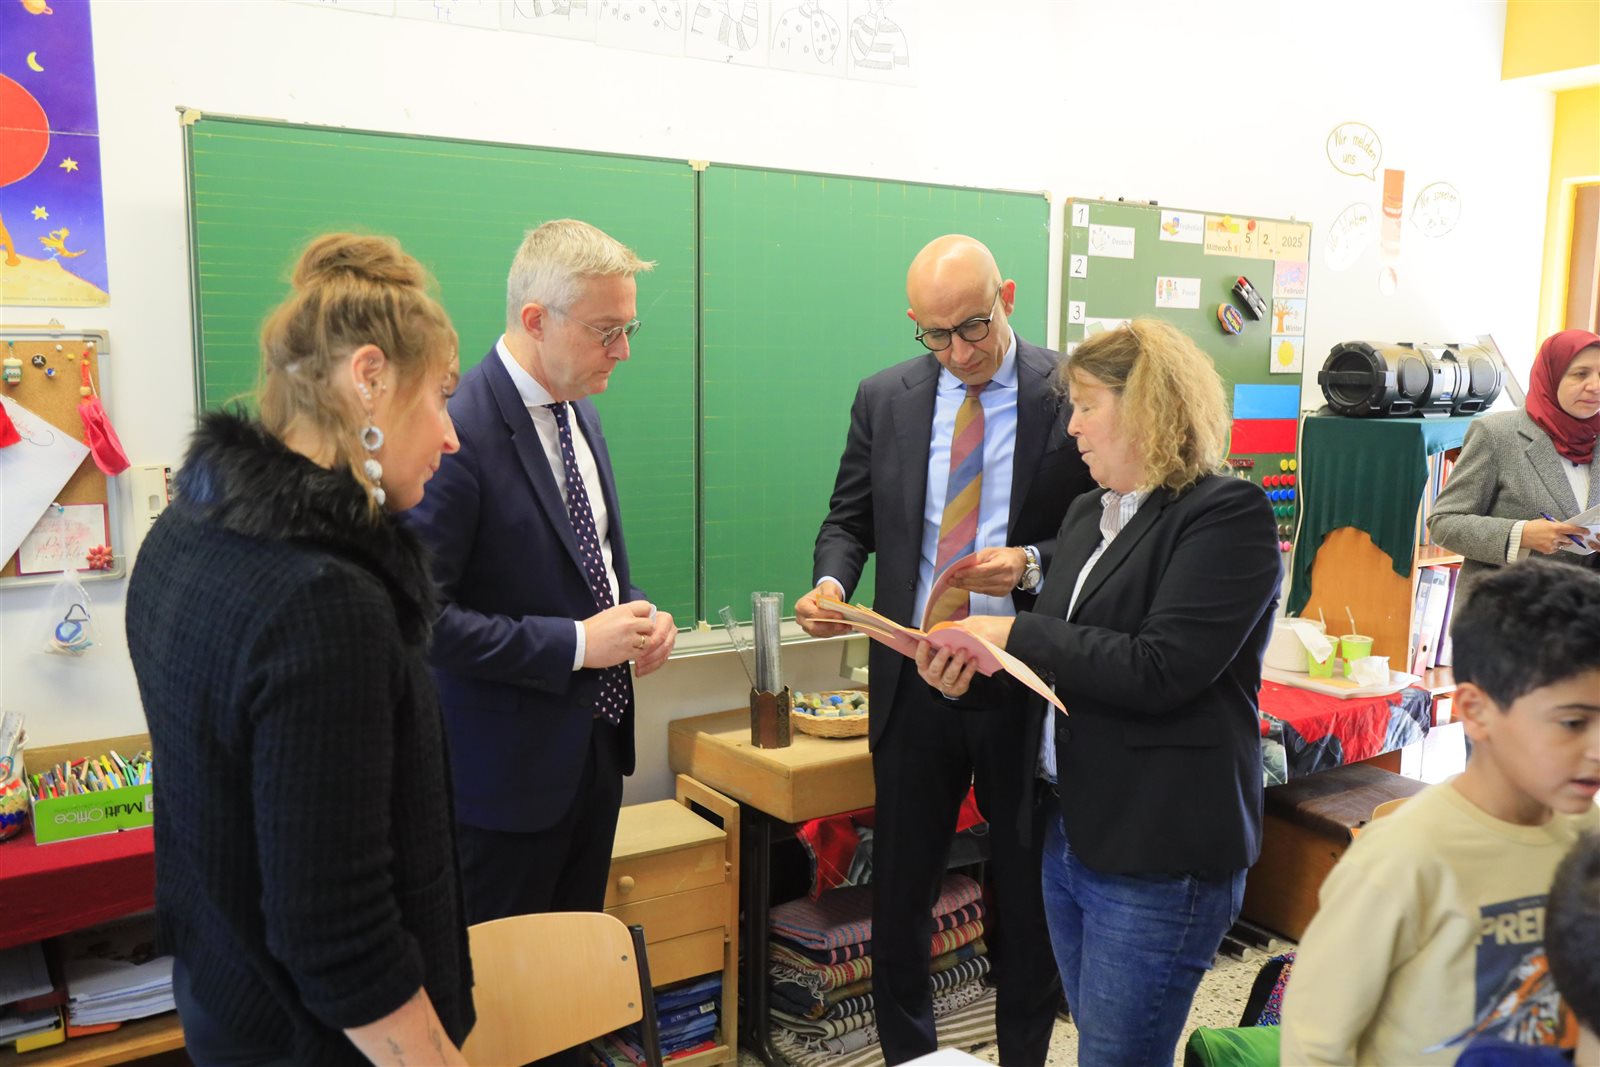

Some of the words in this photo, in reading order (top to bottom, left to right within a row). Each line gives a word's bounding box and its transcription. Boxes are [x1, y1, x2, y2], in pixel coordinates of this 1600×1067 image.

[1334, 129, 1348, 147] Wir
[1352, 131, 1377, 161] melden
[1342, 153, 1357, 165] uns
[1078, 207, 1085, 223] 1
[1111, 237, 1133, 247] Deutsch
[1206, 243, 1232, 252] Mittwoch
[1245, 232, 1253, 244] 5.
[1263, 233, 1271, 245] 2.
[1281, 236, 1303, 248] 2025
[1074, 258, 1083, 274] 2
[1283, 287, 1305, 295] Februar
[1072, 305, 1081, 320] 3
